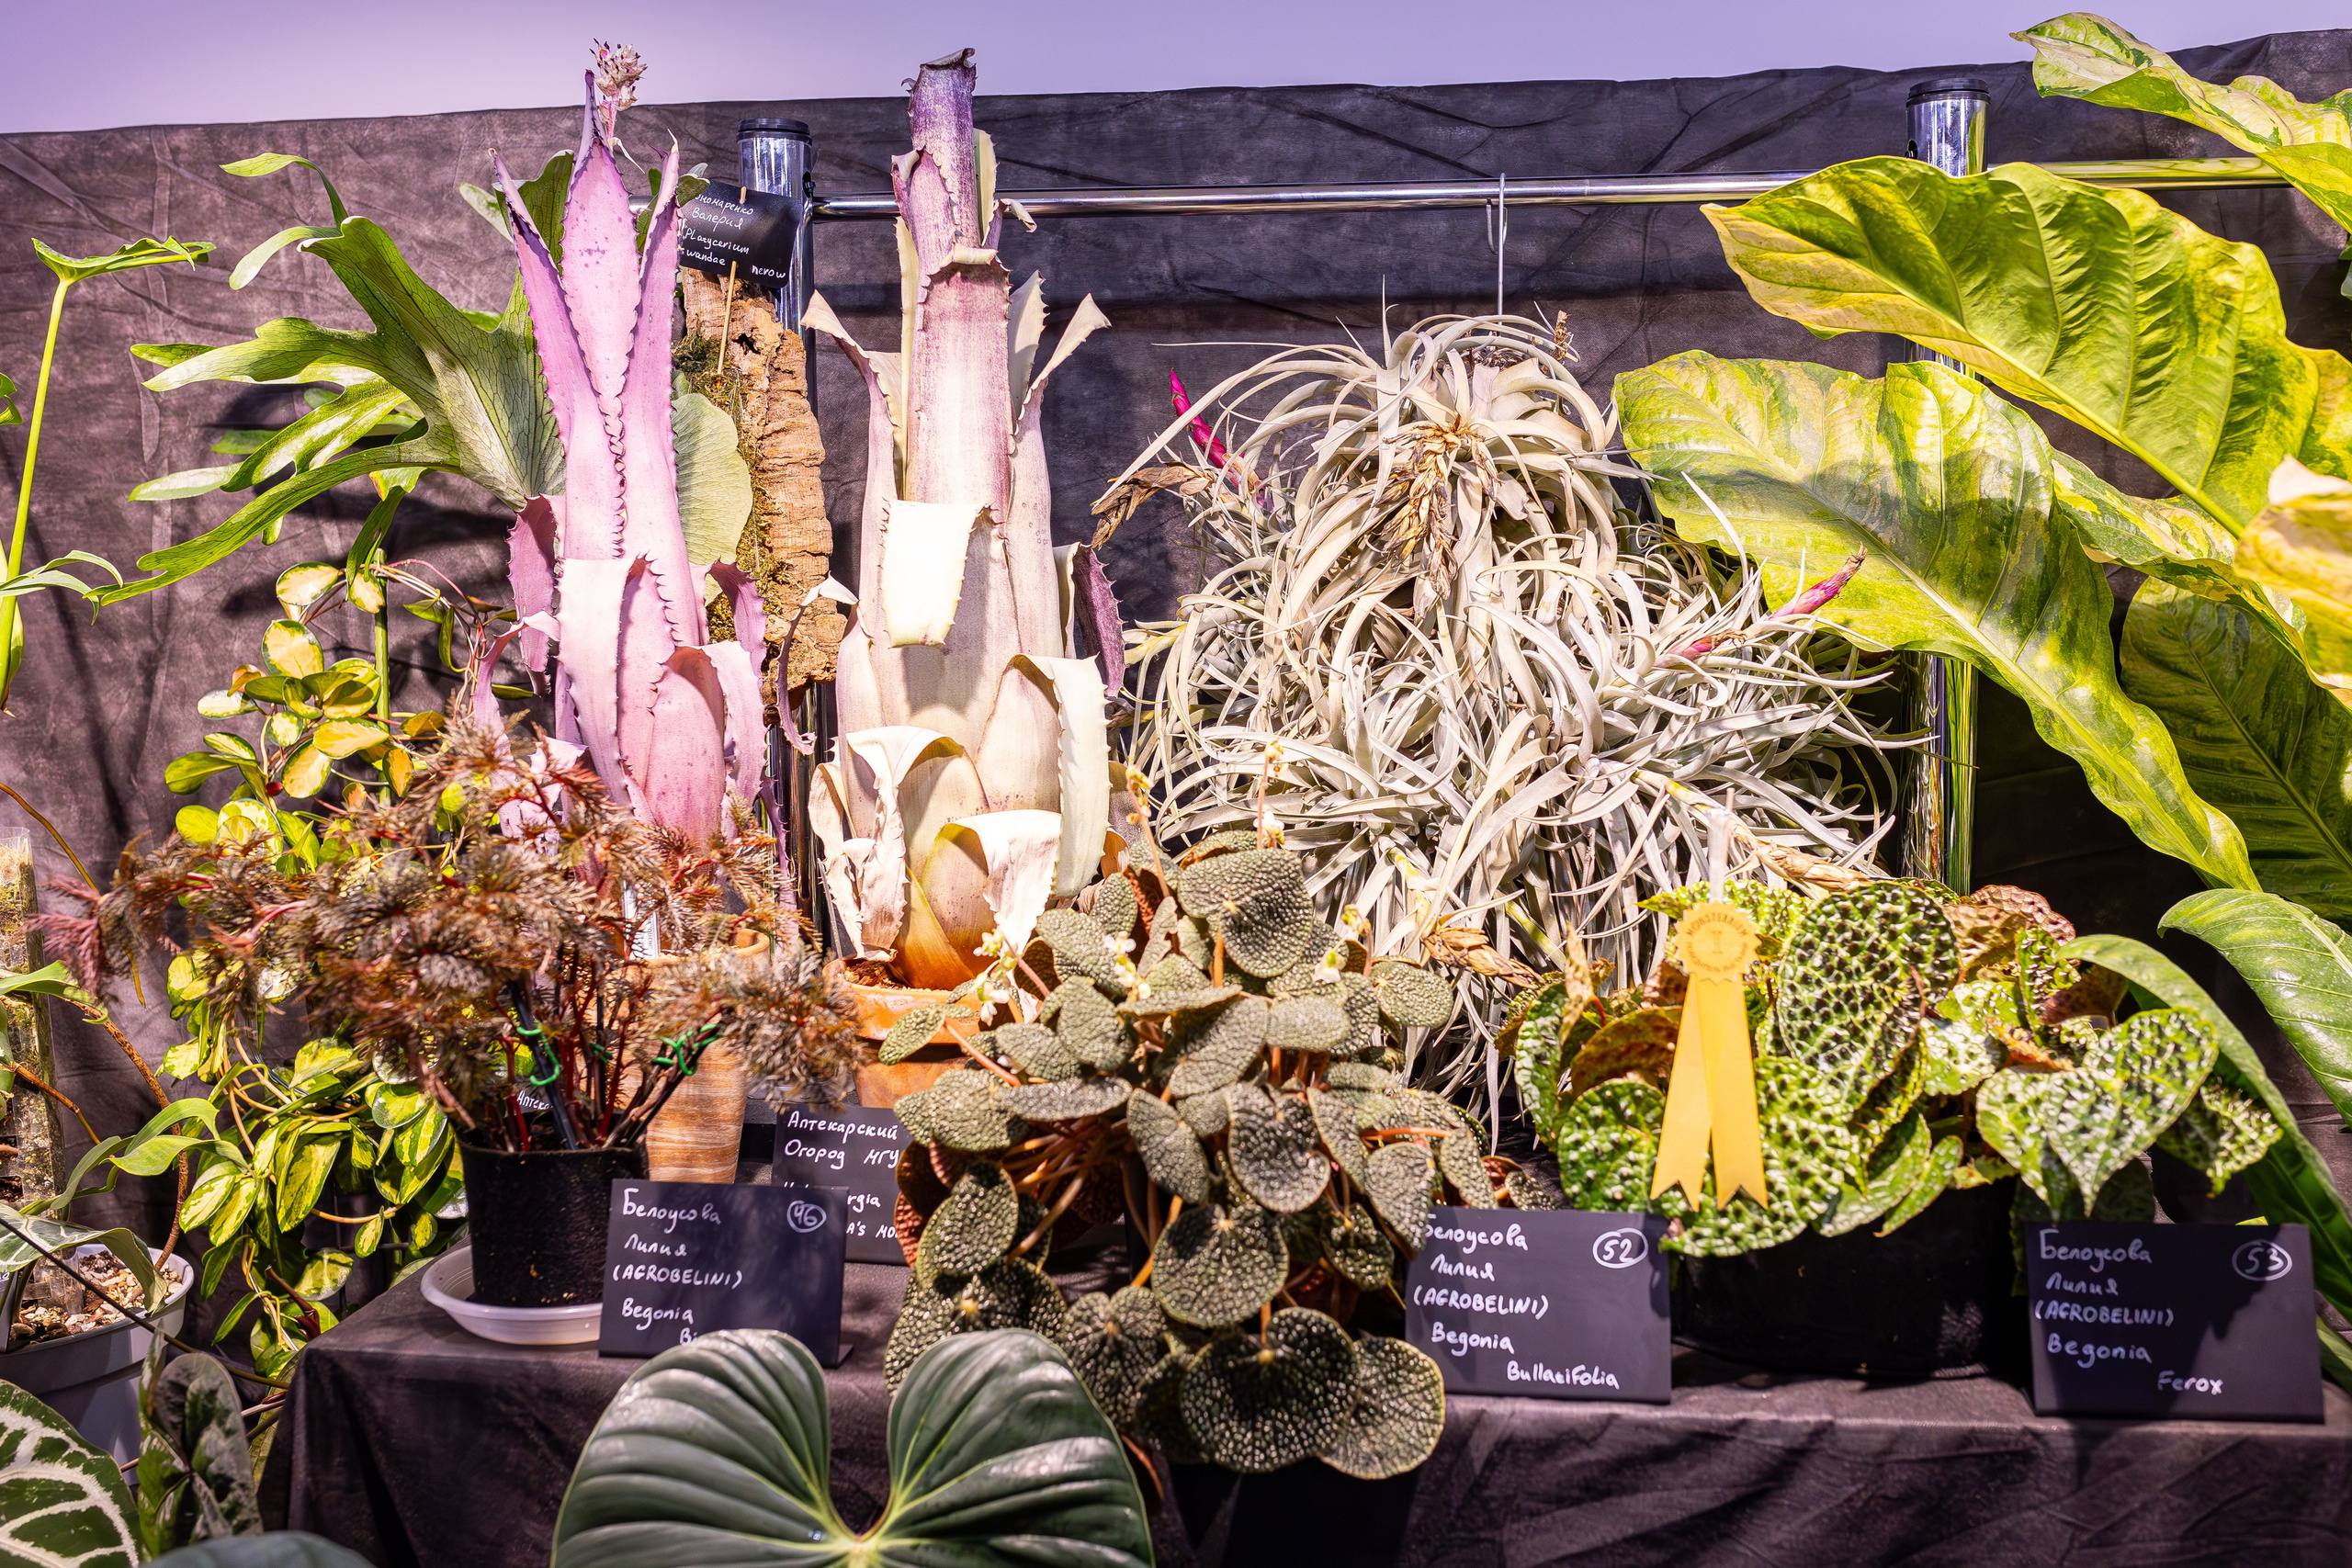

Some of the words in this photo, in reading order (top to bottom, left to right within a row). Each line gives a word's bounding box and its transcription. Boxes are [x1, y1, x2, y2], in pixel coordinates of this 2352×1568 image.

[692, 207, 744, 231] Валерия
[686, 249, 726, 265] wandae
[786, 1111, 899, 1144] Аптекарский
[785, 1139, 845, 1169] Огород
[622, 1188, 721, 1234] Белоусова
[847, 1194, 881, 1213] rgia
[846, 1221, 866, 1236] A's
[876, 1224, 898, 1238] MO
[624, 1233, 687, 1256] Лилия
[1602, 1238, 1634, 1263] 52
[2039, 1228, 2153, 1272] Белоусова
[1430, 1253, 1496, 1282] Лилия
[2245, 1247, 2285, 1274] 53
[613, 1264, 743, 1290] (AGROBELINI)
[2045, 1272, 2119, 1296] Лилия
[622, 1297, 694, 1330] Begonia
[1414, 1285, 1549, 1320] (AGROBELINI)
[1431, 1321, 1515, 1357] Begonia
[2046, 1333, 2153, 1369] Begonia
[2158, 1370, 2224, 1395] Ferox
